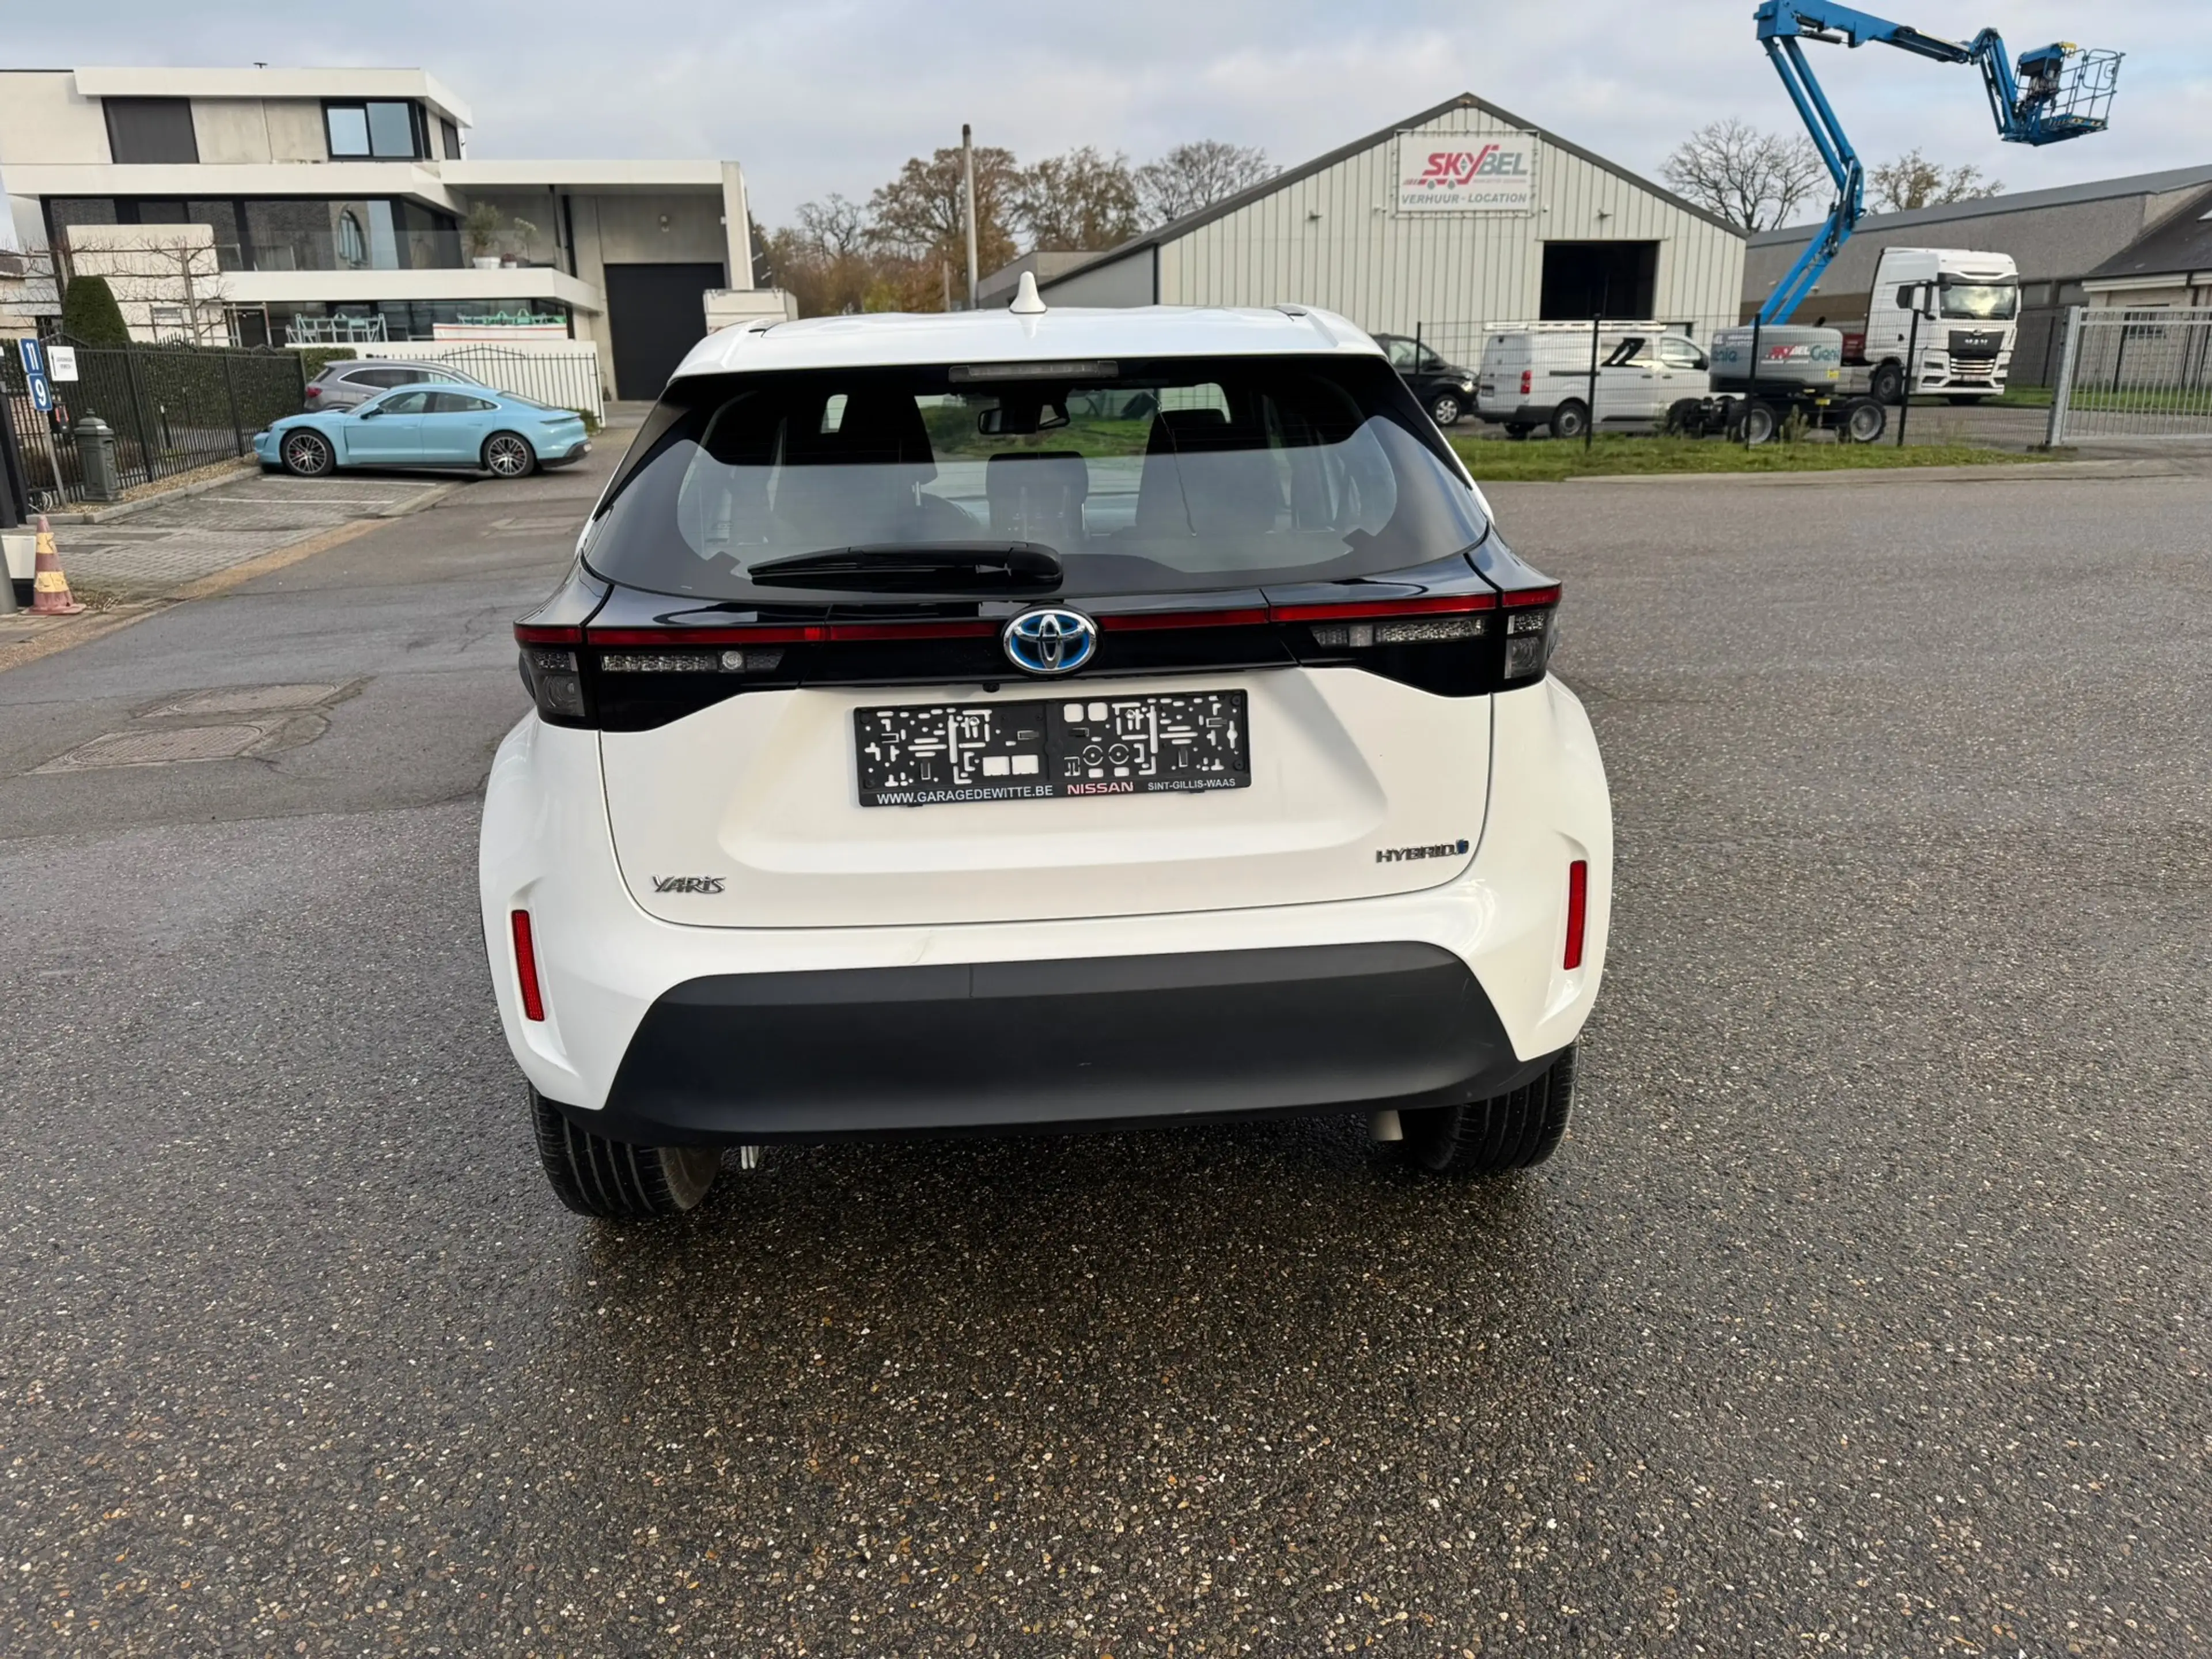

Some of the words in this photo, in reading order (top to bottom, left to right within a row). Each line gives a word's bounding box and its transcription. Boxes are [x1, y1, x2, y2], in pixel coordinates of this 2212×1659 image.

[1422, 144, 1528, 177] SKYBEL
[1402, 193, 1459, 204] VERHUUR
[1468, 193, 1527, 203] LOCATION
[25, 342, 39, 370] 11
[35, 379, 46, 406] 9
[877, 785, 1053, 804] WWW.GARAGEDEWITTE.BE
[1067, 782, 1134, 794] NISSAN
[1148, 778, 1236, 791] SINT-GILLIS-WAAS
[1376, 843, 1456, 863] HYBRID
